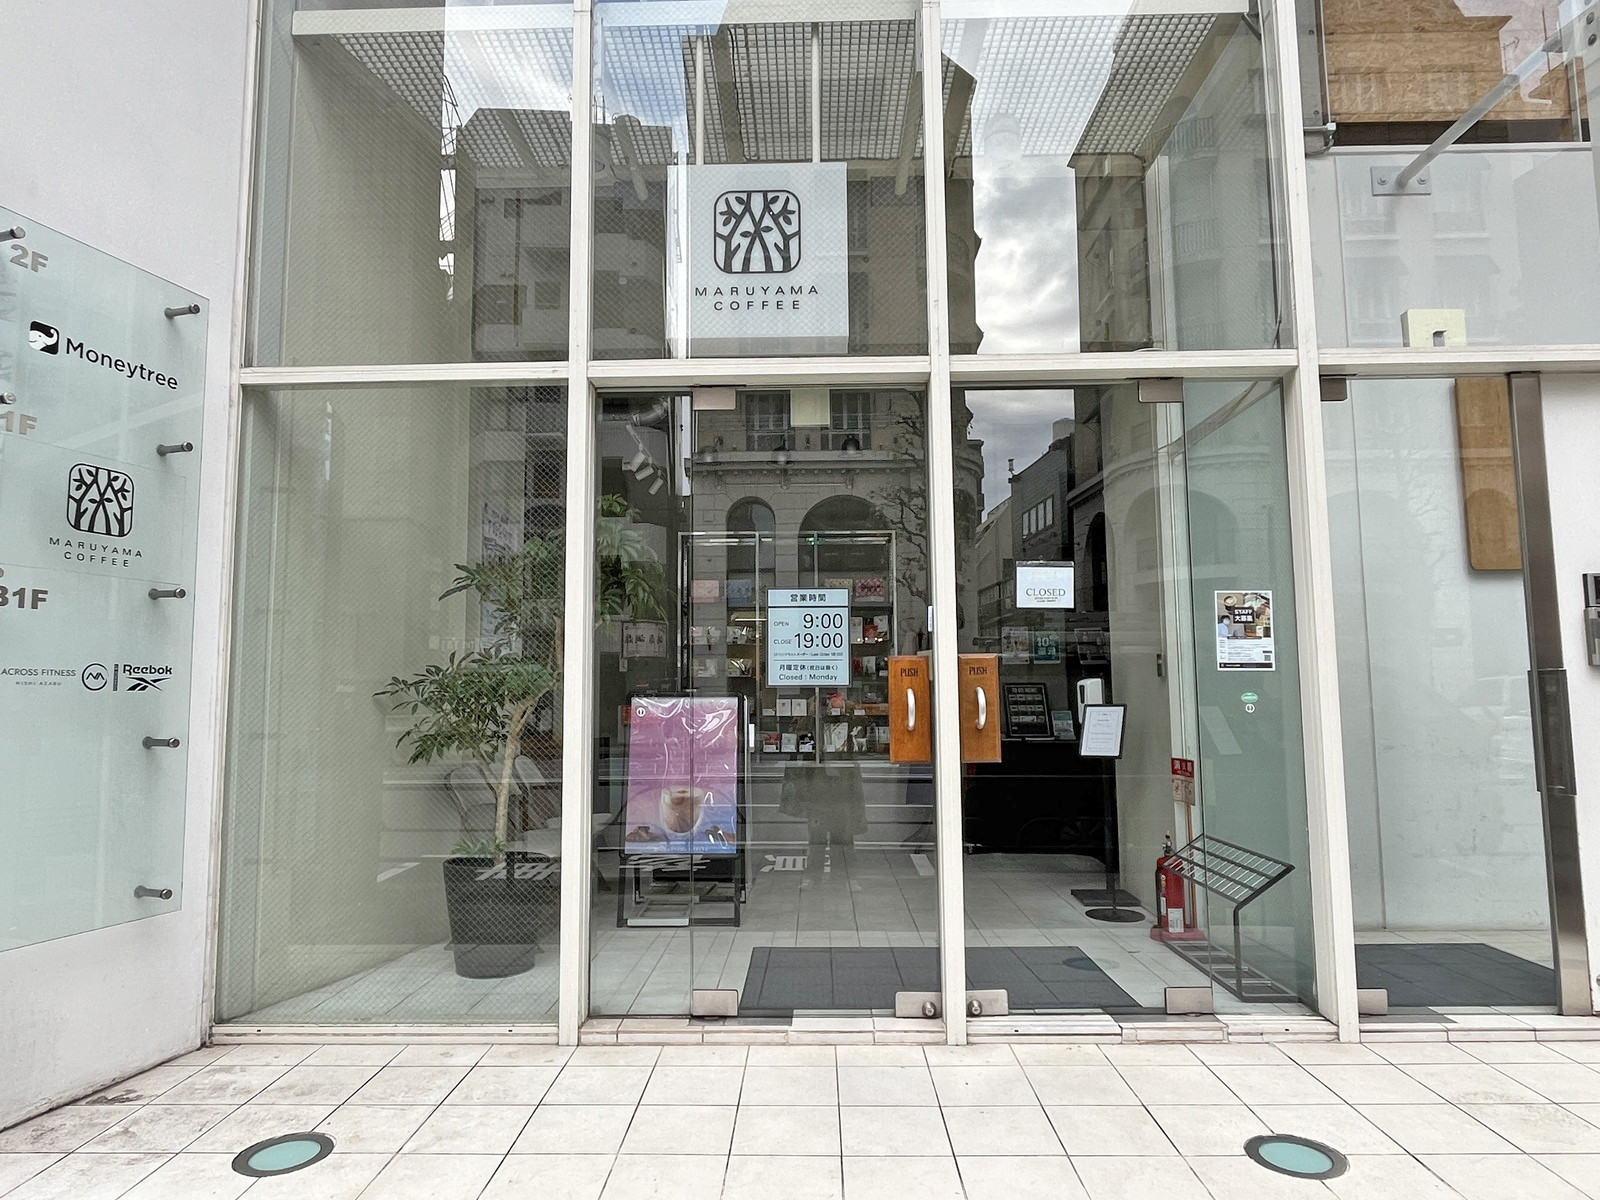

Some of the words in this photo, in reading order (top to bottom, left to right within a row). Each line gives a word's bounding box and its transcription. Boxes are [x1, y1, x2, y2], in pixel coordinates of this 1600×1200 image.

[9, 244, 49, 273] 2F
[695, 285, 819, 297] MARUYAMA
[713, 300, 801, 311] COFFEE
[65, 337, 179, 390] Moneytree
[0, 411, 38, 436] 1F
[48, 537, 144, 559] MARUYAMA
[63, 551, 131, 568] COFFEE
[790, 593, 827, 603] 営業時間
[1025, 587, 1066, 597] CLOSED
[803, 613, 843, 630] 9:00
[794, 632, 843, 649] 19:00
[1, 667, 39, 677] ACROSS
[41, 668, 77, 677] FITNESS
[123, 664, 173, 676] Reebok
[900, 667, 919, 678] PUSH
[968, 666, 988, 676] PUSH
[778, 673, 803, 681] Closed
[809, 673, 838, 682] Monday
